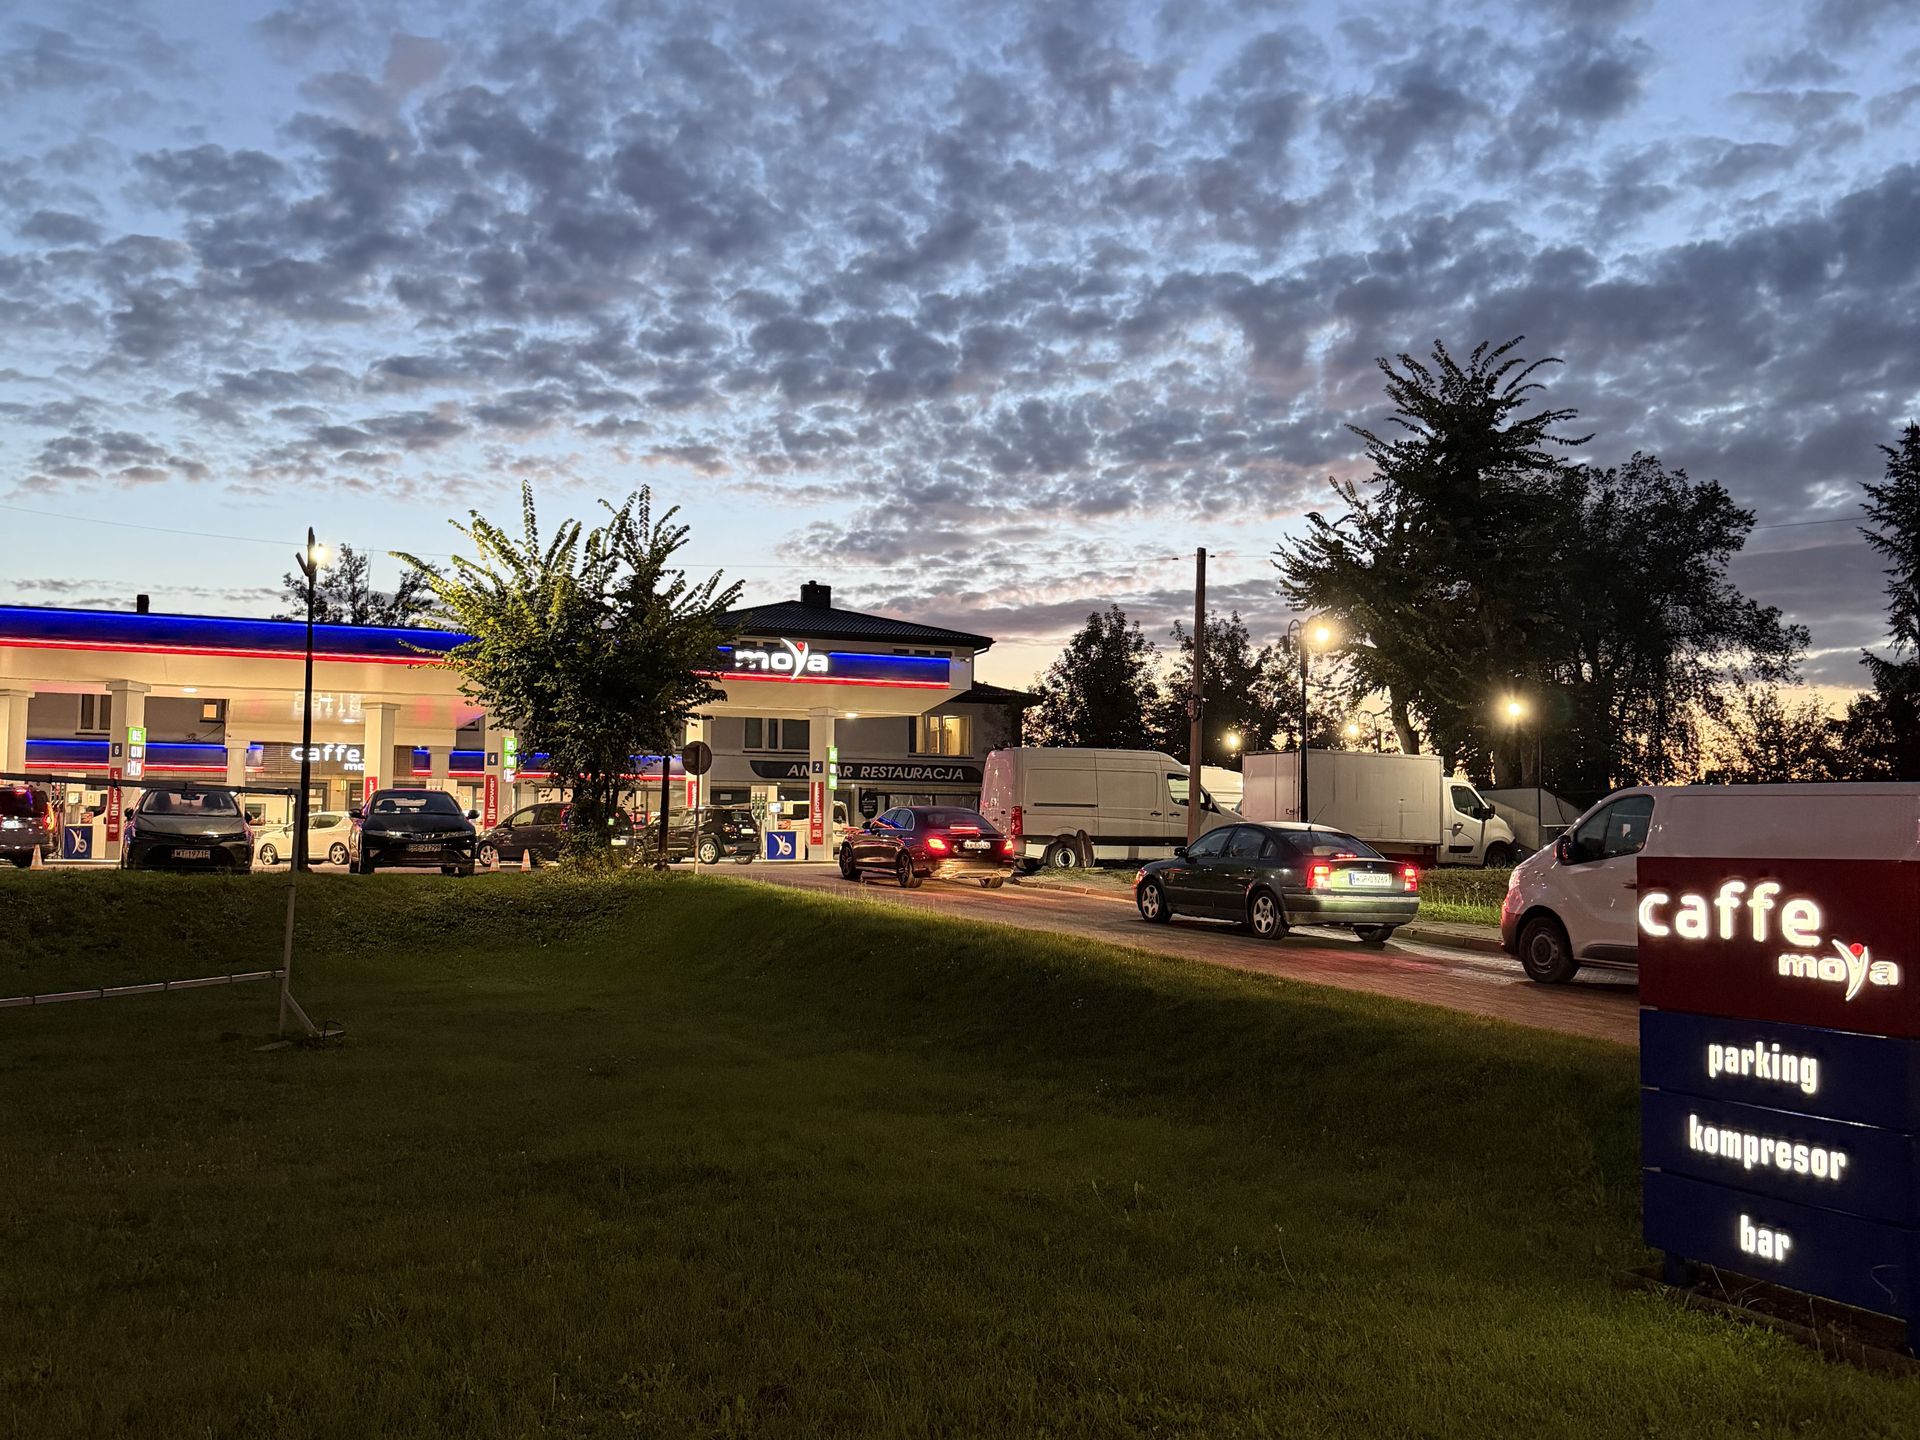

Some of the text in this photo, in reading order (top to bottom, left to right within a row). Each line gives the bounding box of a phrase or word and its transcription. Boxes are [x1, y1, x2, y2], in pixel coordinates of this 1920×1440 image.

[114, 745, 120, 755] 6
[290, 744, 361, 763] caffe
[490, 754, 495, 764] 4
[343, 762, 365, 771] mo
[815, 763, 820, 772] 2
[860, 764, 964, 780] RESTAURACJA
[1638, 880, 1821, 947] caffe
[1778, 938, 1899, 1001] moya
[1708, 1041, 1818, 1094] parking
[1688, 1114, 1846, 1180] kompresor
[1740, 1214, 1790, 1260] bar
